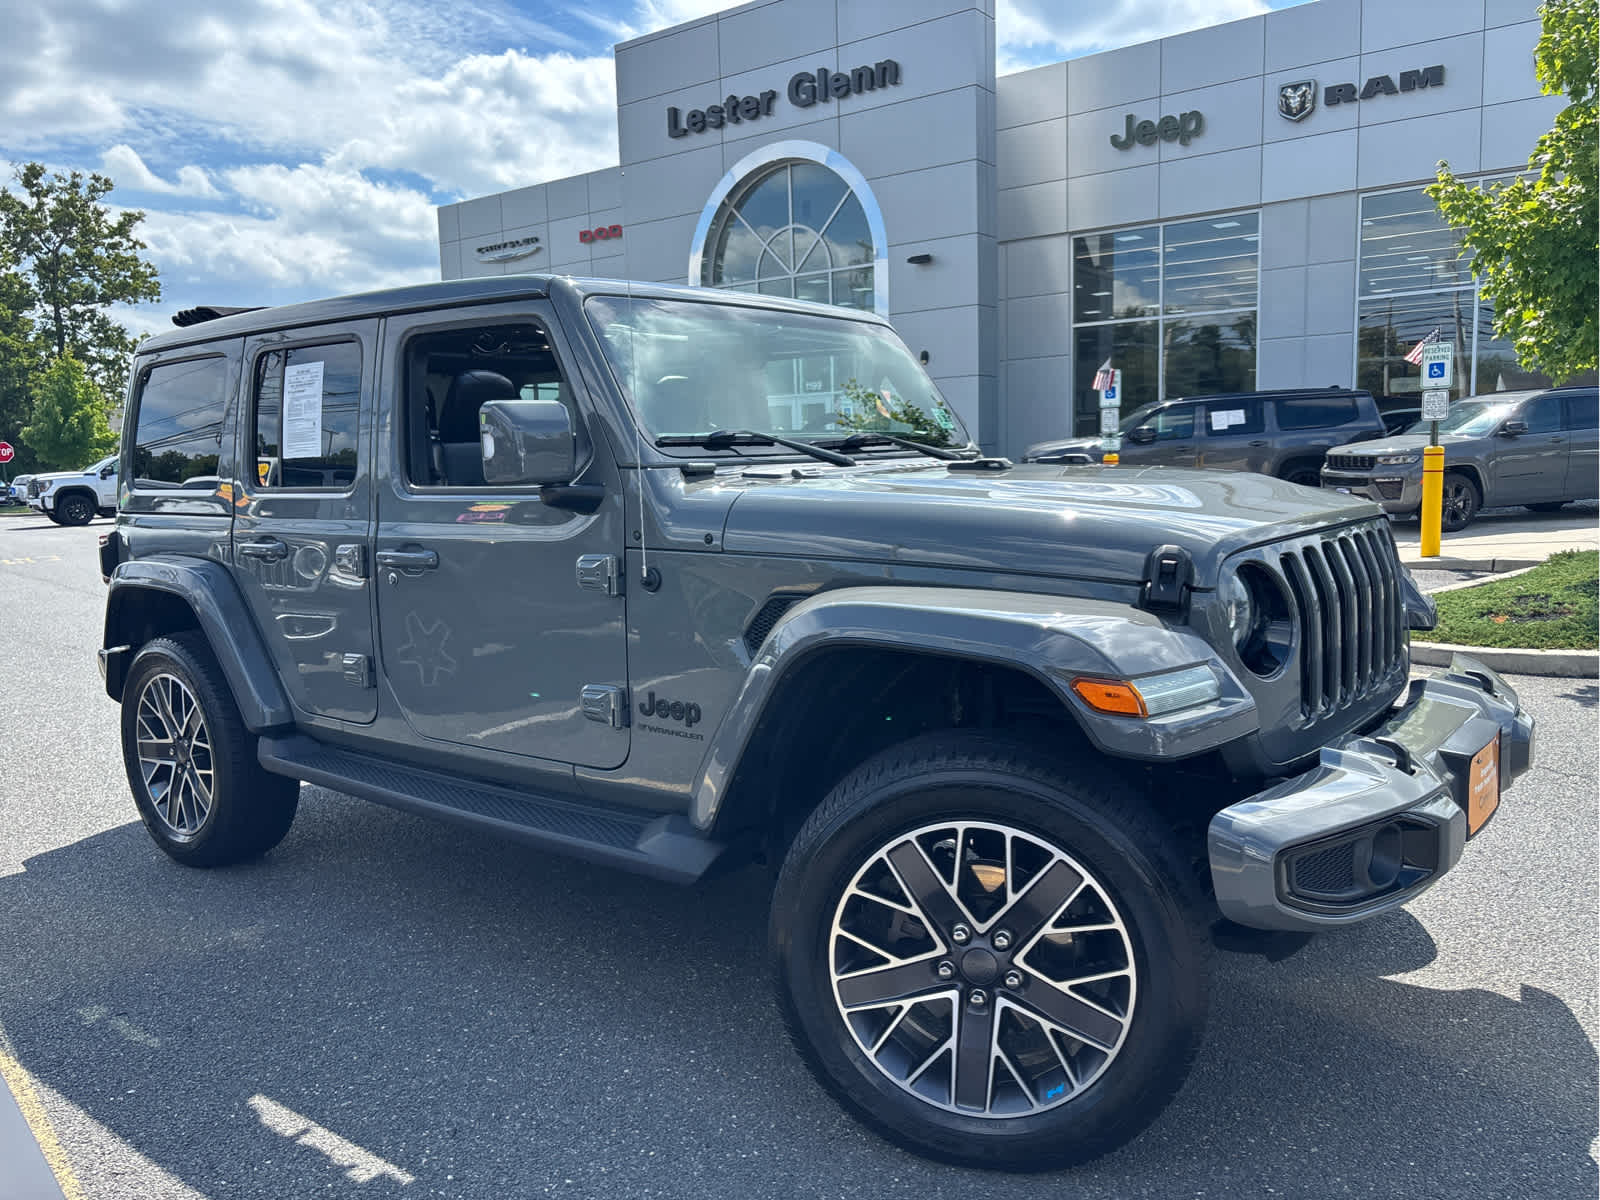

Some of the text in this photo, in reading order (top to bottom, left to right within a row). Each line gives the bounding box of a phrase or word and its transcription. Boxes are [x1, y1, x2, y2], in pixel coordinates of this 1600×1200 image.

[667, 59, 901, 139] Lester Glenn
[1324, 65, 1446, 106] RAM
[1110, 109, 1205, 150] Jeep
[1424, 346, 1451, 354] RESERVED
[1424, 354, 1450, 362] PARKING
[639, 691, 702, 728] Jeep
